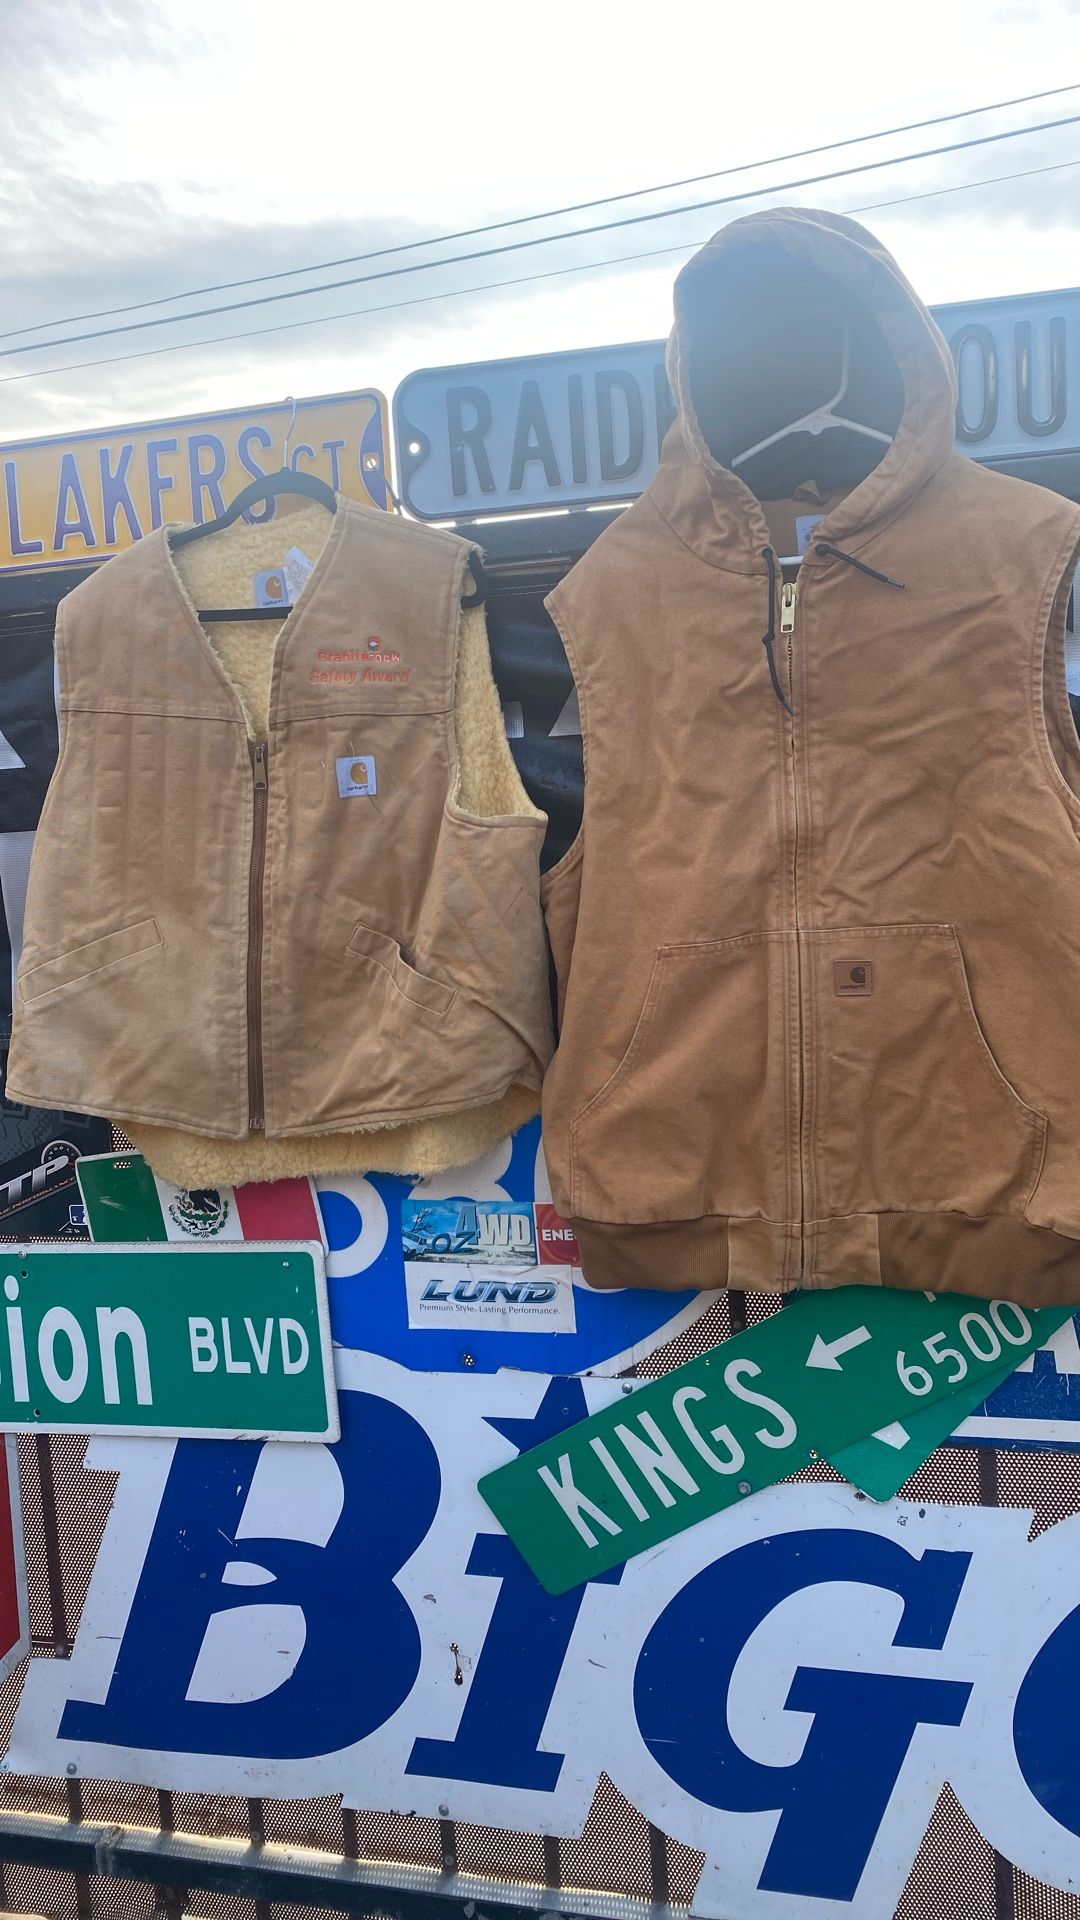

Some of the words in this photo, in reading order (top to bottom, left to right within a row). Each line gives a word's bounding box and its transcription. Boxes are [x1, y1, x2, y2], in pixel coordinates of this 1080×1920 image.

[4, 427, 277, 556] LAKERS
[309, 667, 357, 686] Safety
[361, 667, 411, 684] Award
[456, 1205, 531, 1246] 4WD
[542, 1228, 578, 1242] ENE
[419, 1279, 560, 1304] LUND
[419, 1303, 454, 1312] Premium
[455, 1304, 477, 1314] Style.
[479, 1305, 507, 1316] Lasting
[508, 1306, 561, 1316] Performance.
[0, 1275, 153, 1406] ion
[188, 1316, 310, 1376] BLVD
[536, 1358, 798, 1549] KINGS
[896, 1299, 1033, 1397] 6500
